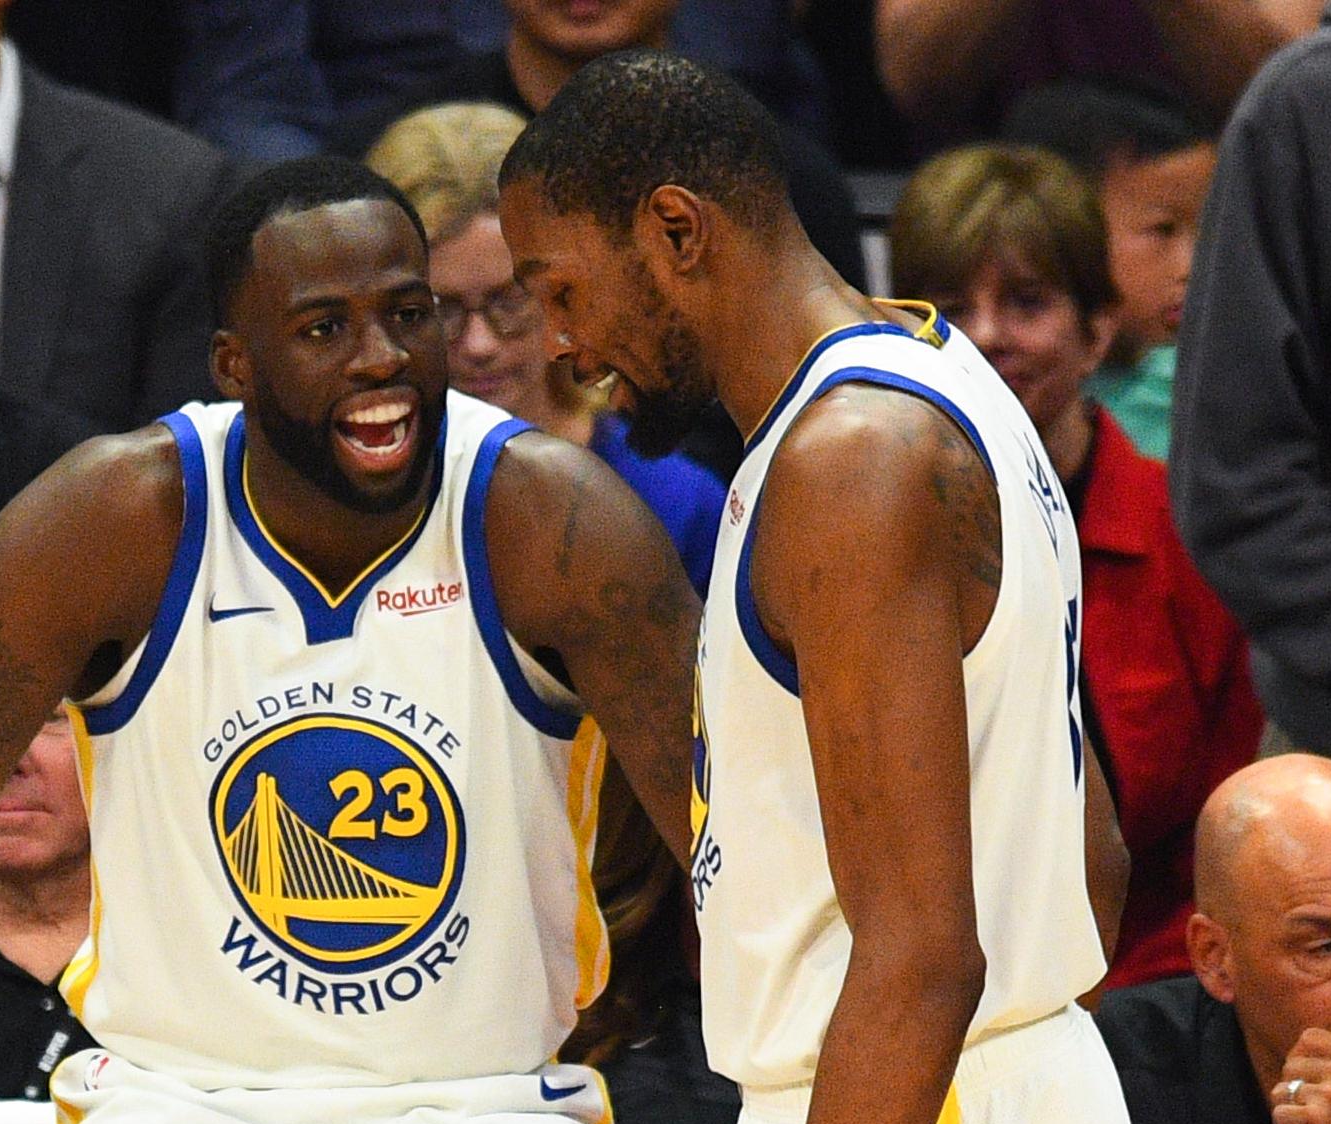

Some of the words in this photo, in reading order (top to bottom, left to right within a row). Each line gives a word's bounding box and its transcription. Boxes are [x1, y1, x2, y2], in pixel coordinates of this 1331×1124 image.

[203, 681, 335, 763] GOLDEN
[351, 686, 462, 760] STATE
[328, 769, 429, 841] 23
[219, 911, 471, 1016] WARRIORS
